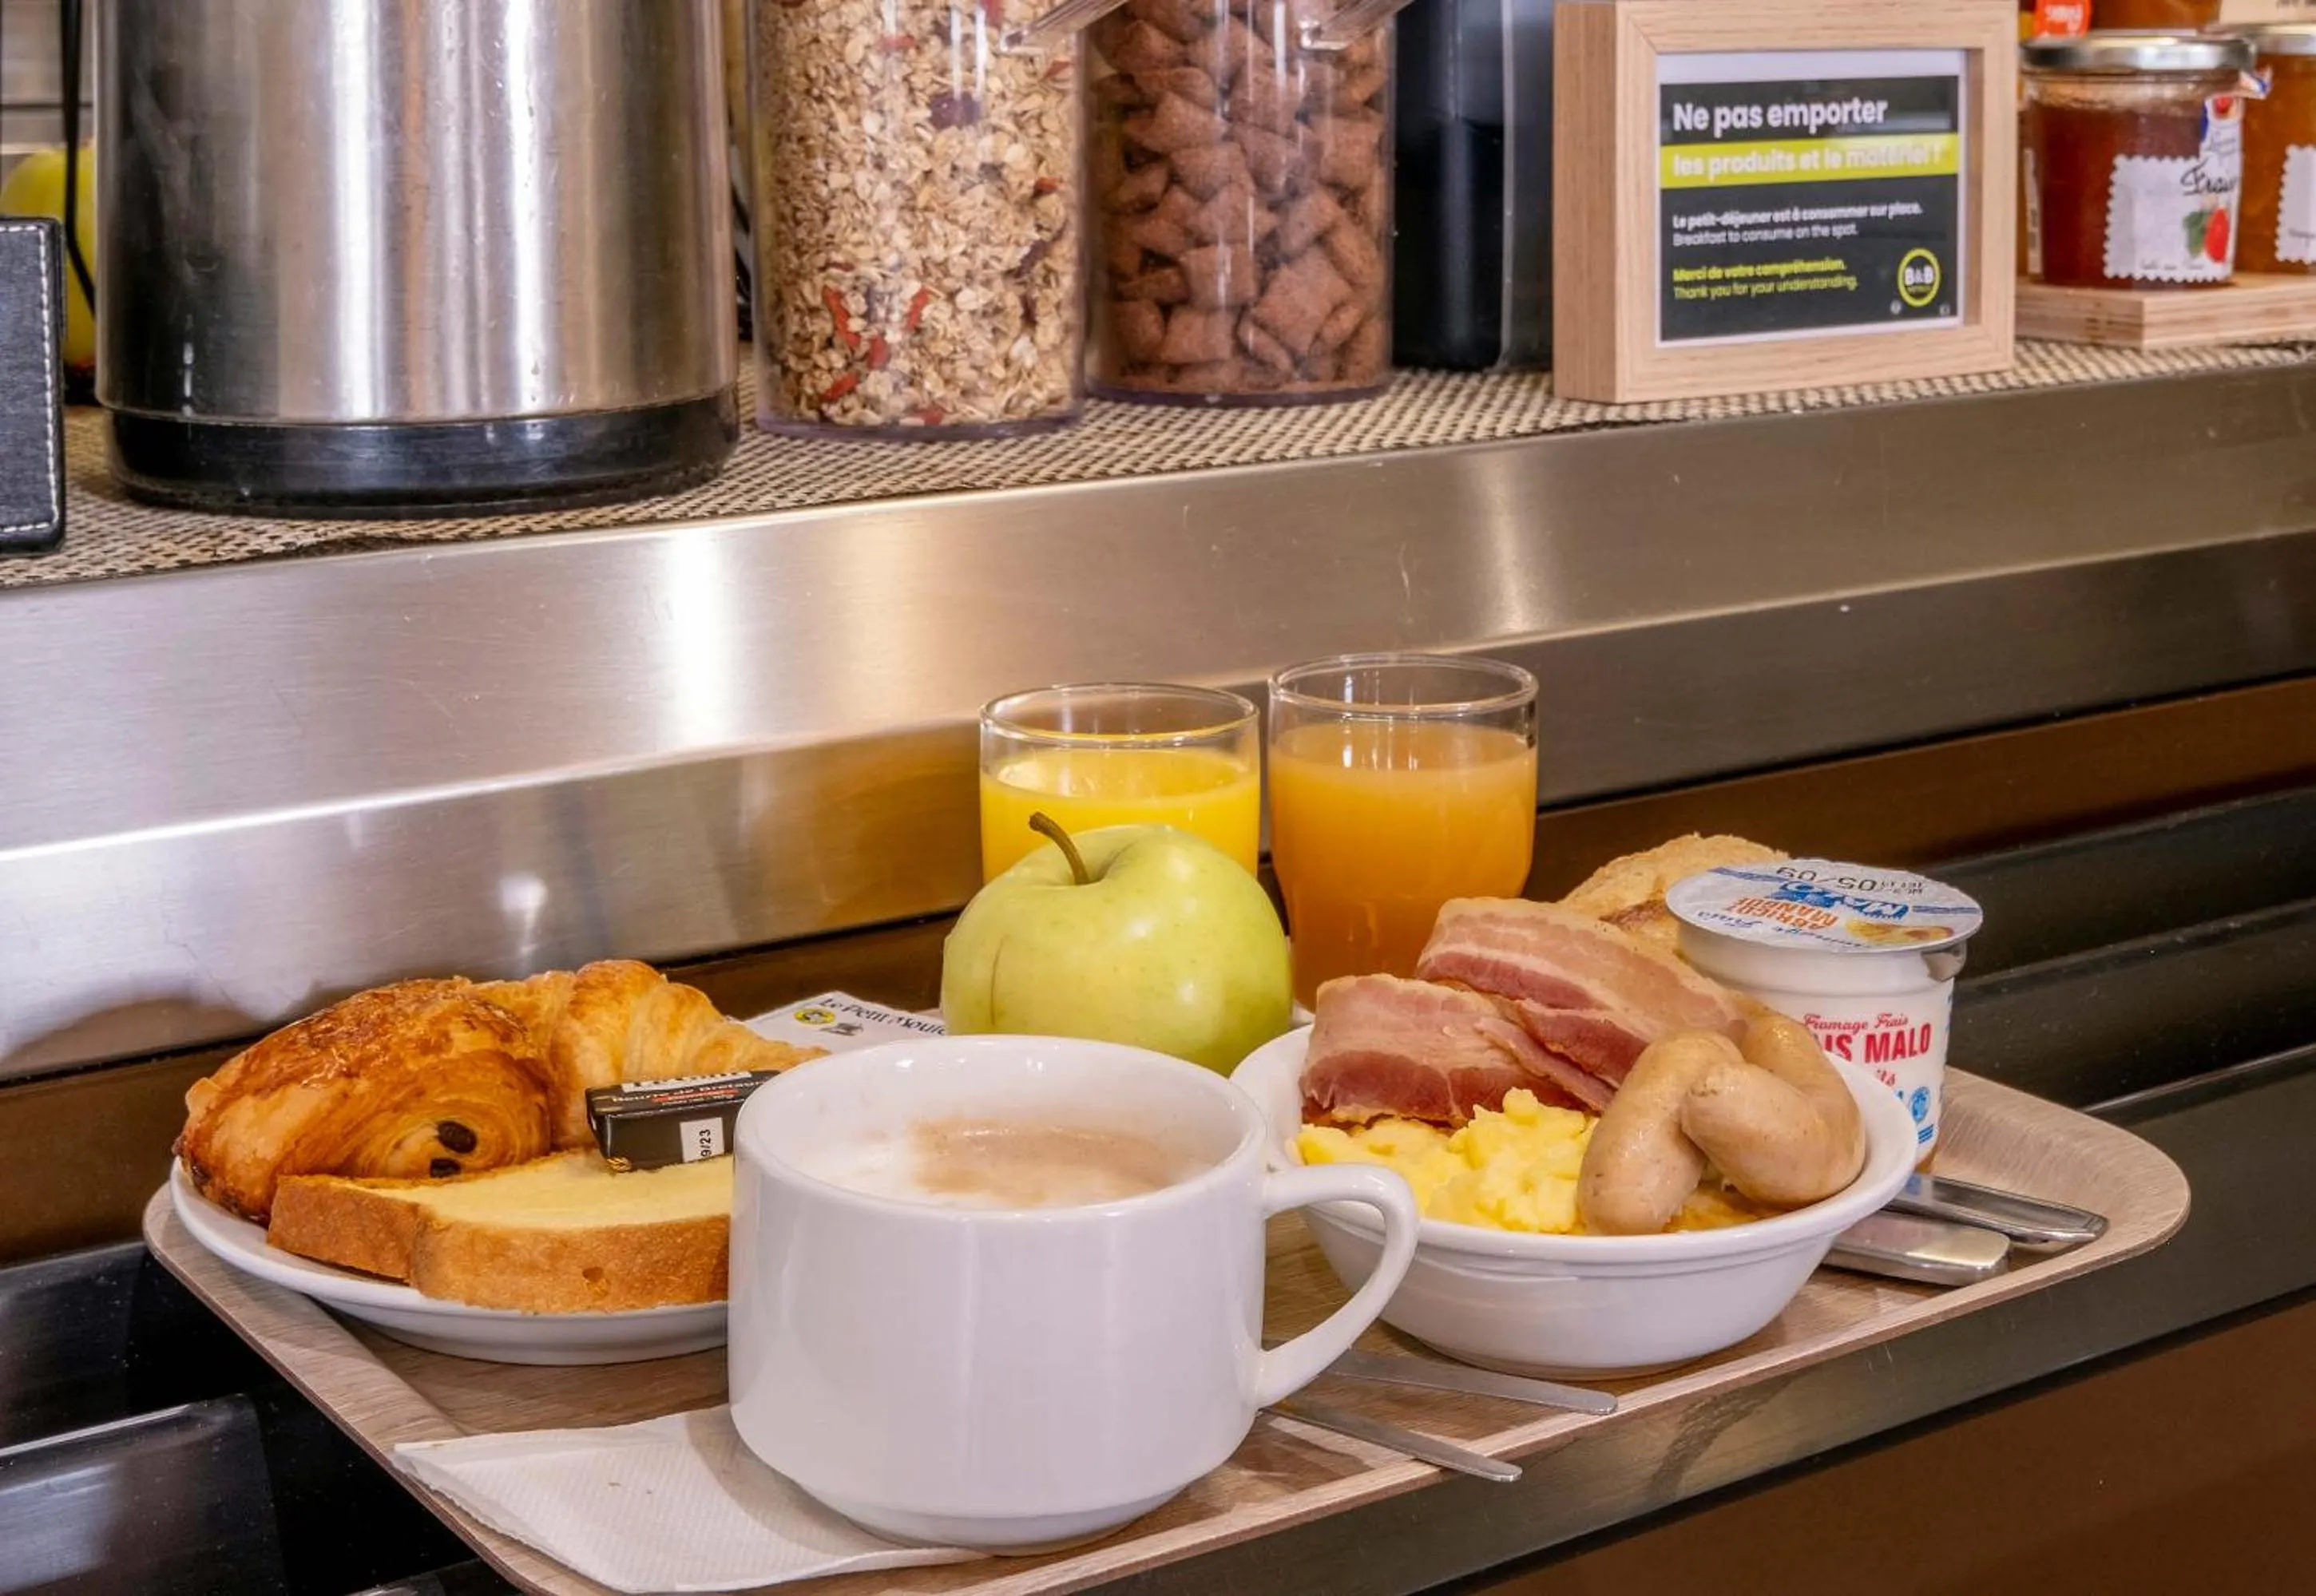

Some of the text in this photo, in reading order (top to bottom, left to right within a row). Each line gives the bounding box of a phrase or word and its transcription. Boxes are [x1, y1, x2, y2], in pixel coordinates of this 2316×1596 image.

[1672, 96, 1889, 139] Ne pas emporter
[1673, 152, 1703, 177] les
[1708, 149, 1795, 183] produits
[1799, 149, 1819, 171] et
[1824, 146, 1842, 170] le
[1672, 215, 1687, 228] Le
[1672, 222, 1858, 247] Breakfast to consume on the spot.
[1672, 266, 1707, 282] Merci
[1707, 267, 1723, 279] de
[1674, 284, 1707, 299] Thank
[1709, 284, 1731, 301] you
[1732, 283, 1748, 295] for
[1750, 282, 1775, 299] your
[1776, 866, 1877, 892] 05/09
[842, 1003, 890, 1024] Petit
[1803, 1012, 1909, 1035] Fromage Frais
[1864, 1022, 1932, 1064] MALO
